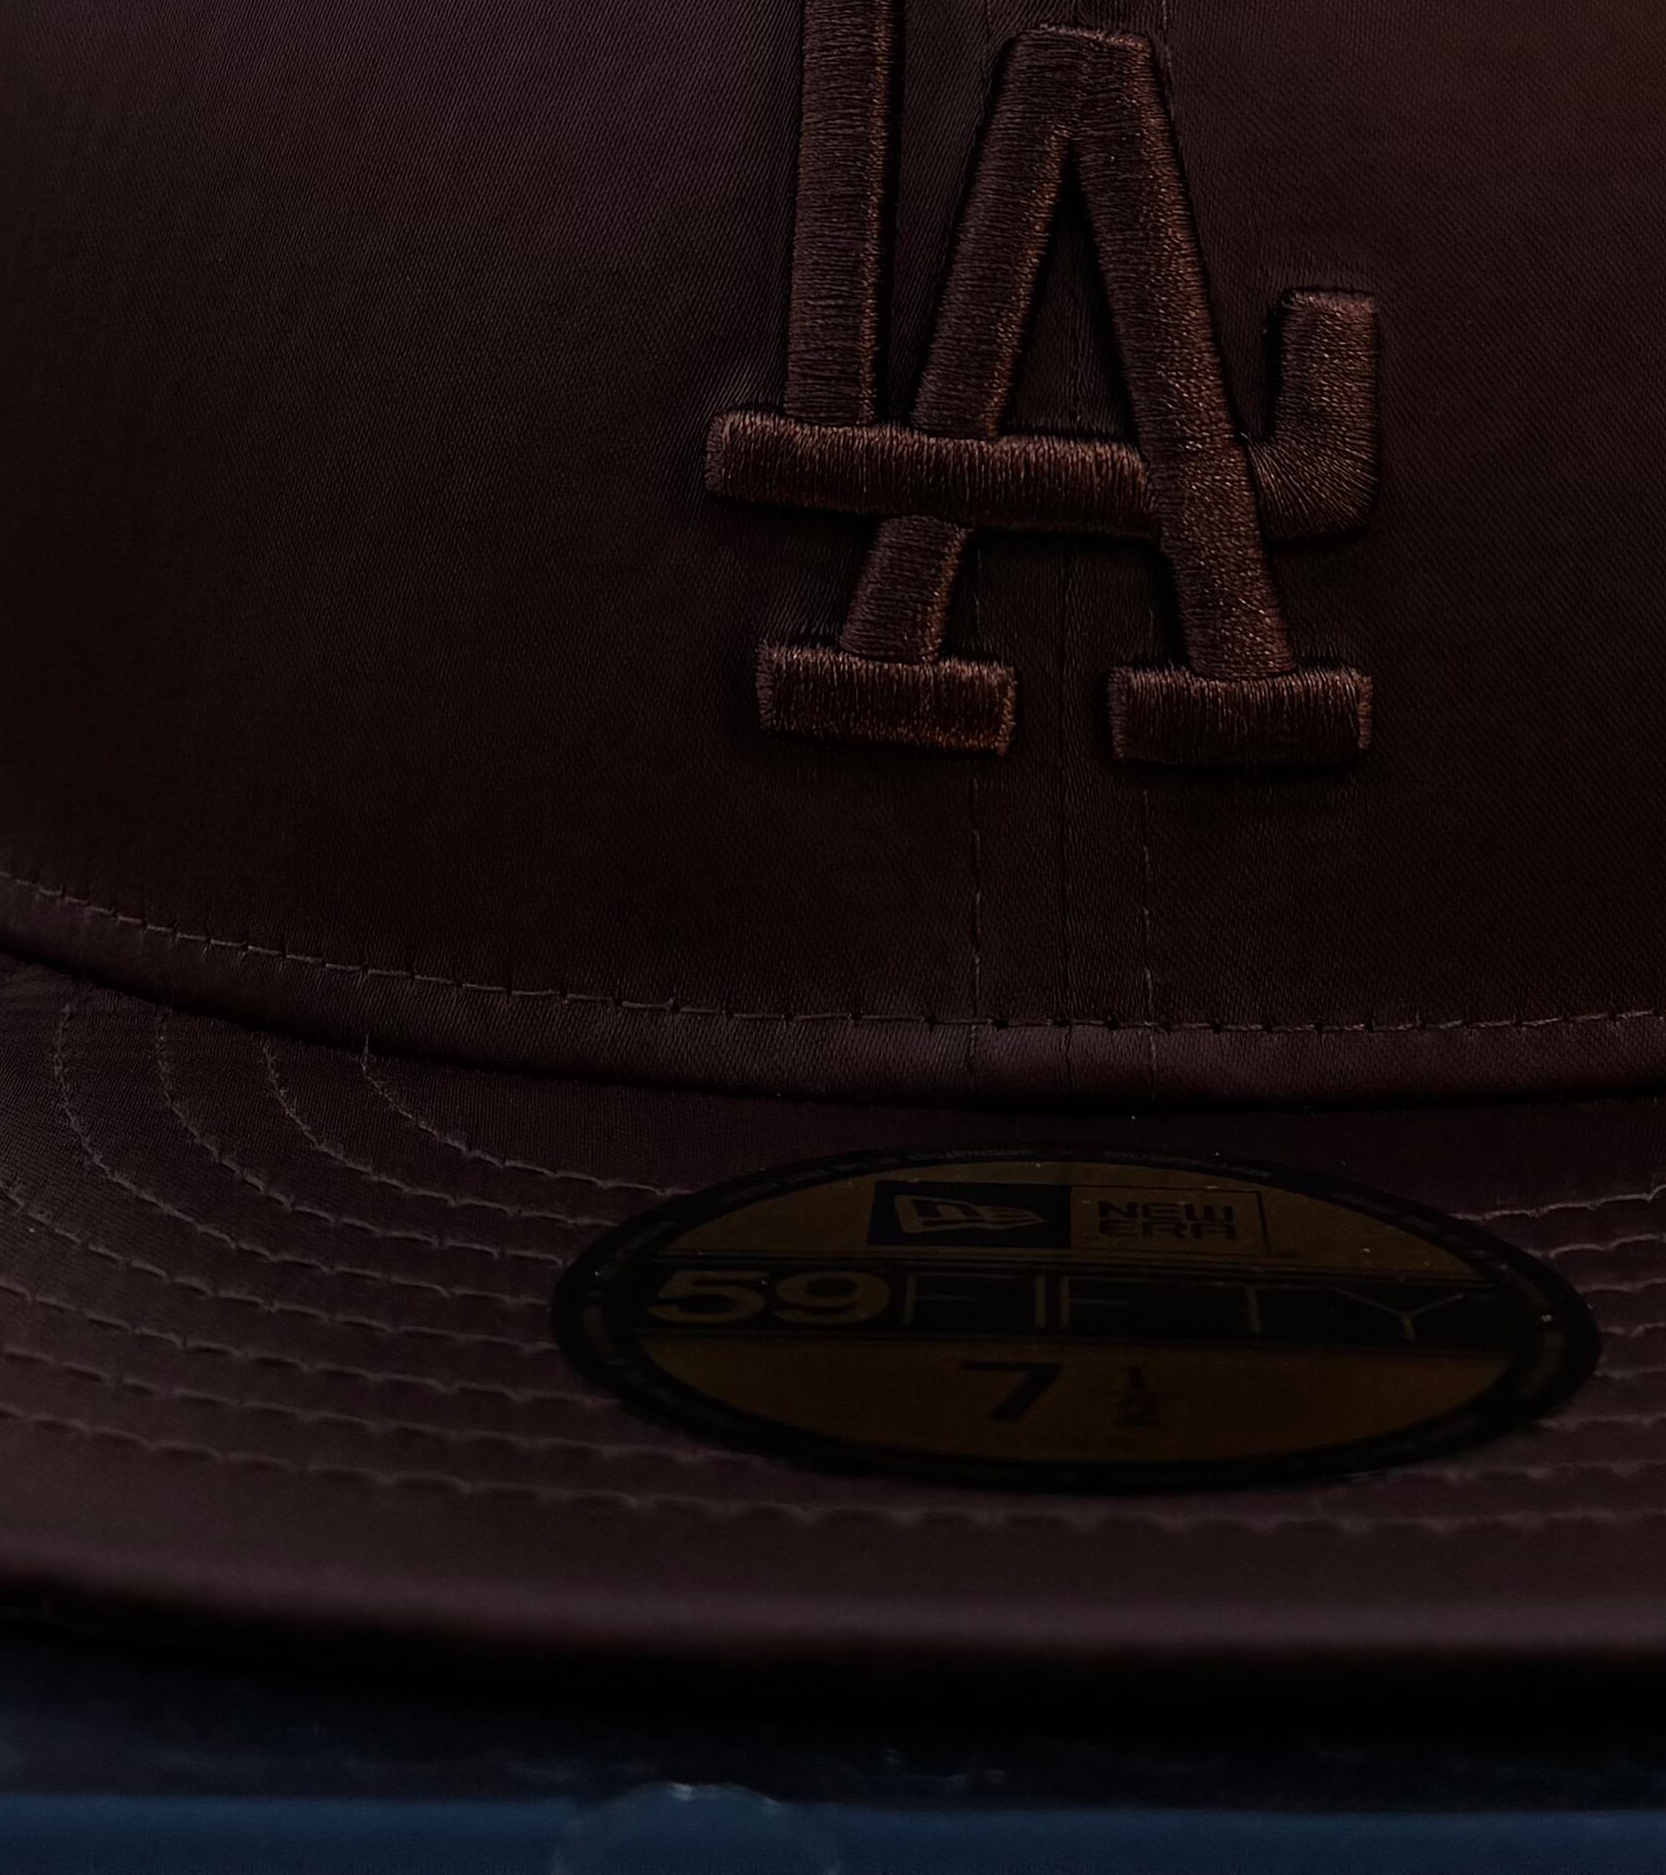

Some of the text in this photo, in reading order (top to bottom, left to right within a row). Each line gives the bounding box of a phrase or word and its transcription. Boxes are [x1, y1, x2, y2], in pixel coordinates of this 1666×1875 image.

[1098, 1200, 1237, 1219] NEW
[1098, 1220, 1238, 1240] ERA
[957, 1361, 1063, 1422] 7
